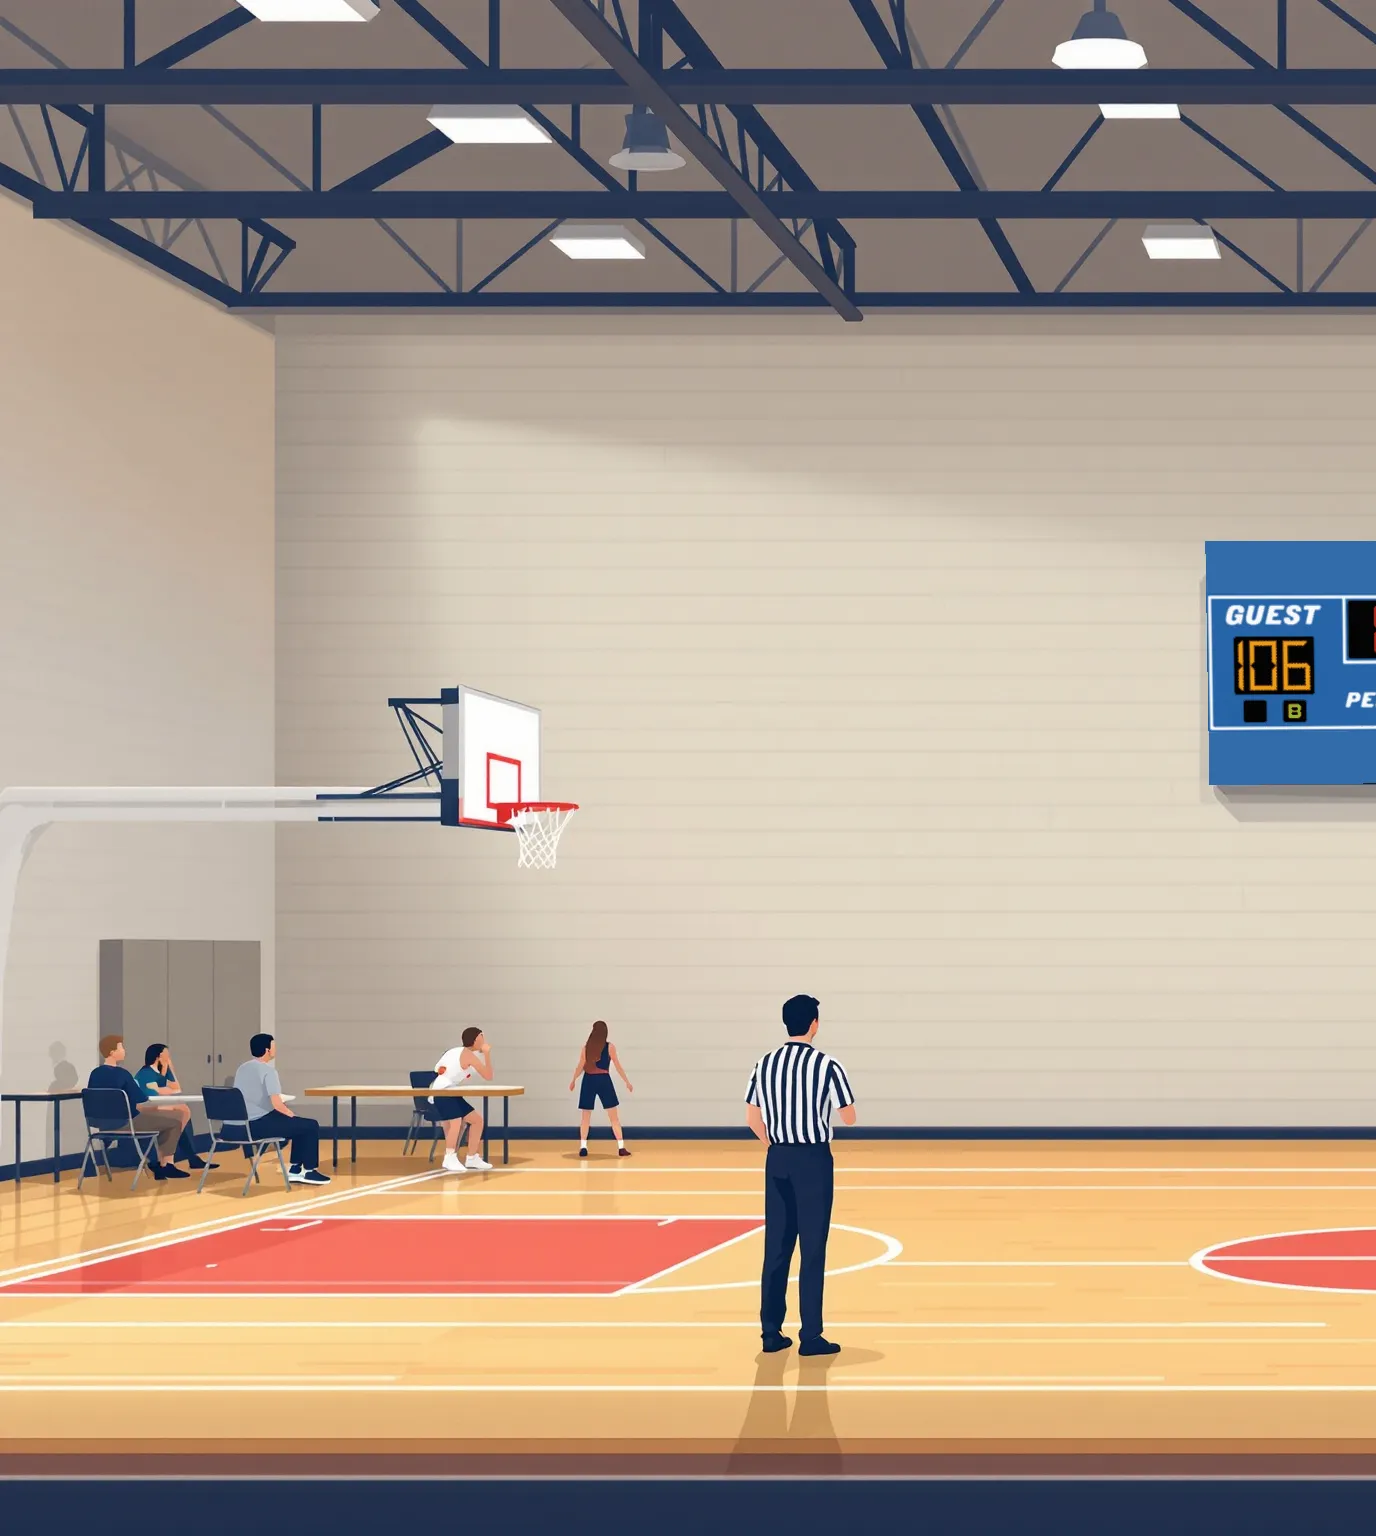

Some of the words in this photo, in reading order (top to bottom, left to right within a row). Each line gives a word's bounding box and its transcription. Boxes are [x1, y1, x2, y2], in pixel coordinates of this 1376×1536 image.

[1225, 605, 1320, 625] GUEST
[1238, 640, 1312, 691] 106
[1287, 703, 1302, 719] B
